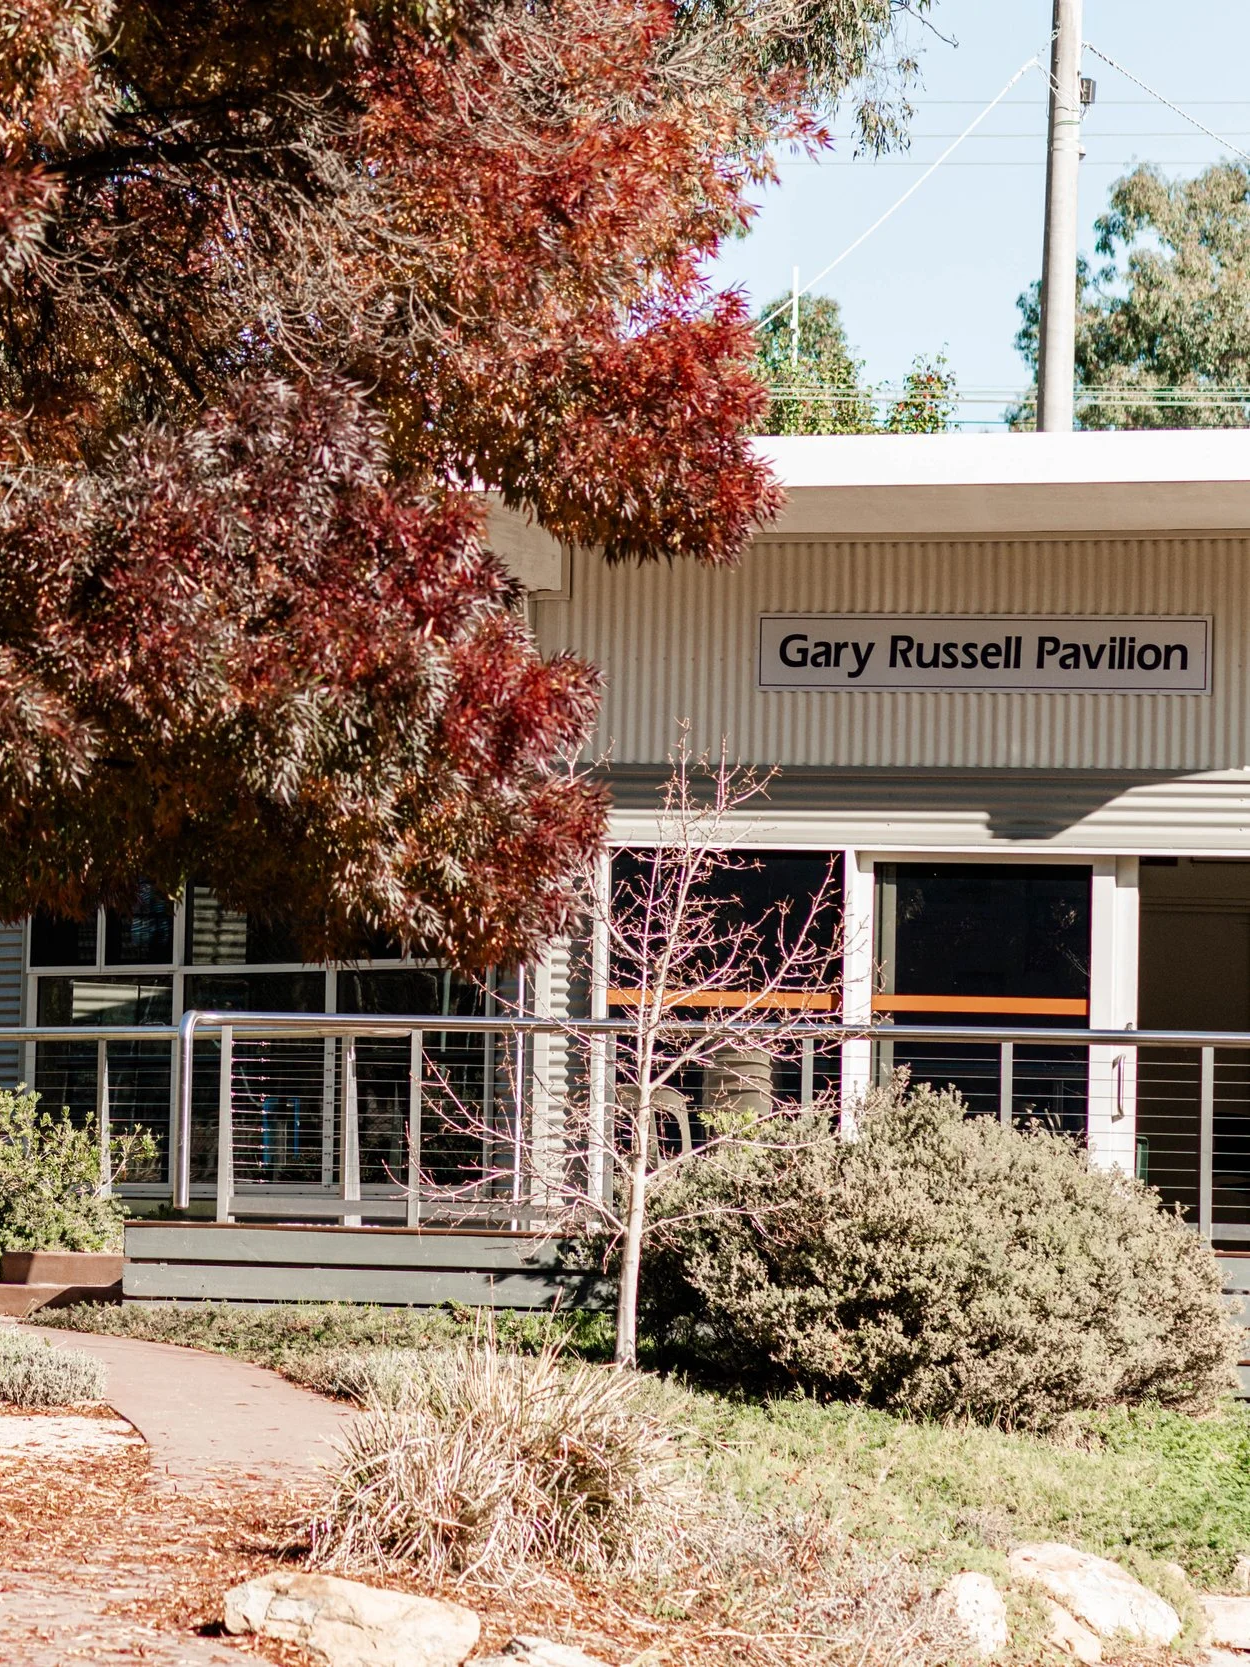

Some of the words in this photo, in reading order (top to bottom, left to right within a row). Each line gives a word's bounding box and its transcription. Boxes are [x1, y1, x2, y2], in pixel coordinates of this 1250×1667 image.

[778, 633, 875, 679] Gary
[888, 634, 1023, 670] Russell
[1036, 635, 1189, 671] Pavilion
